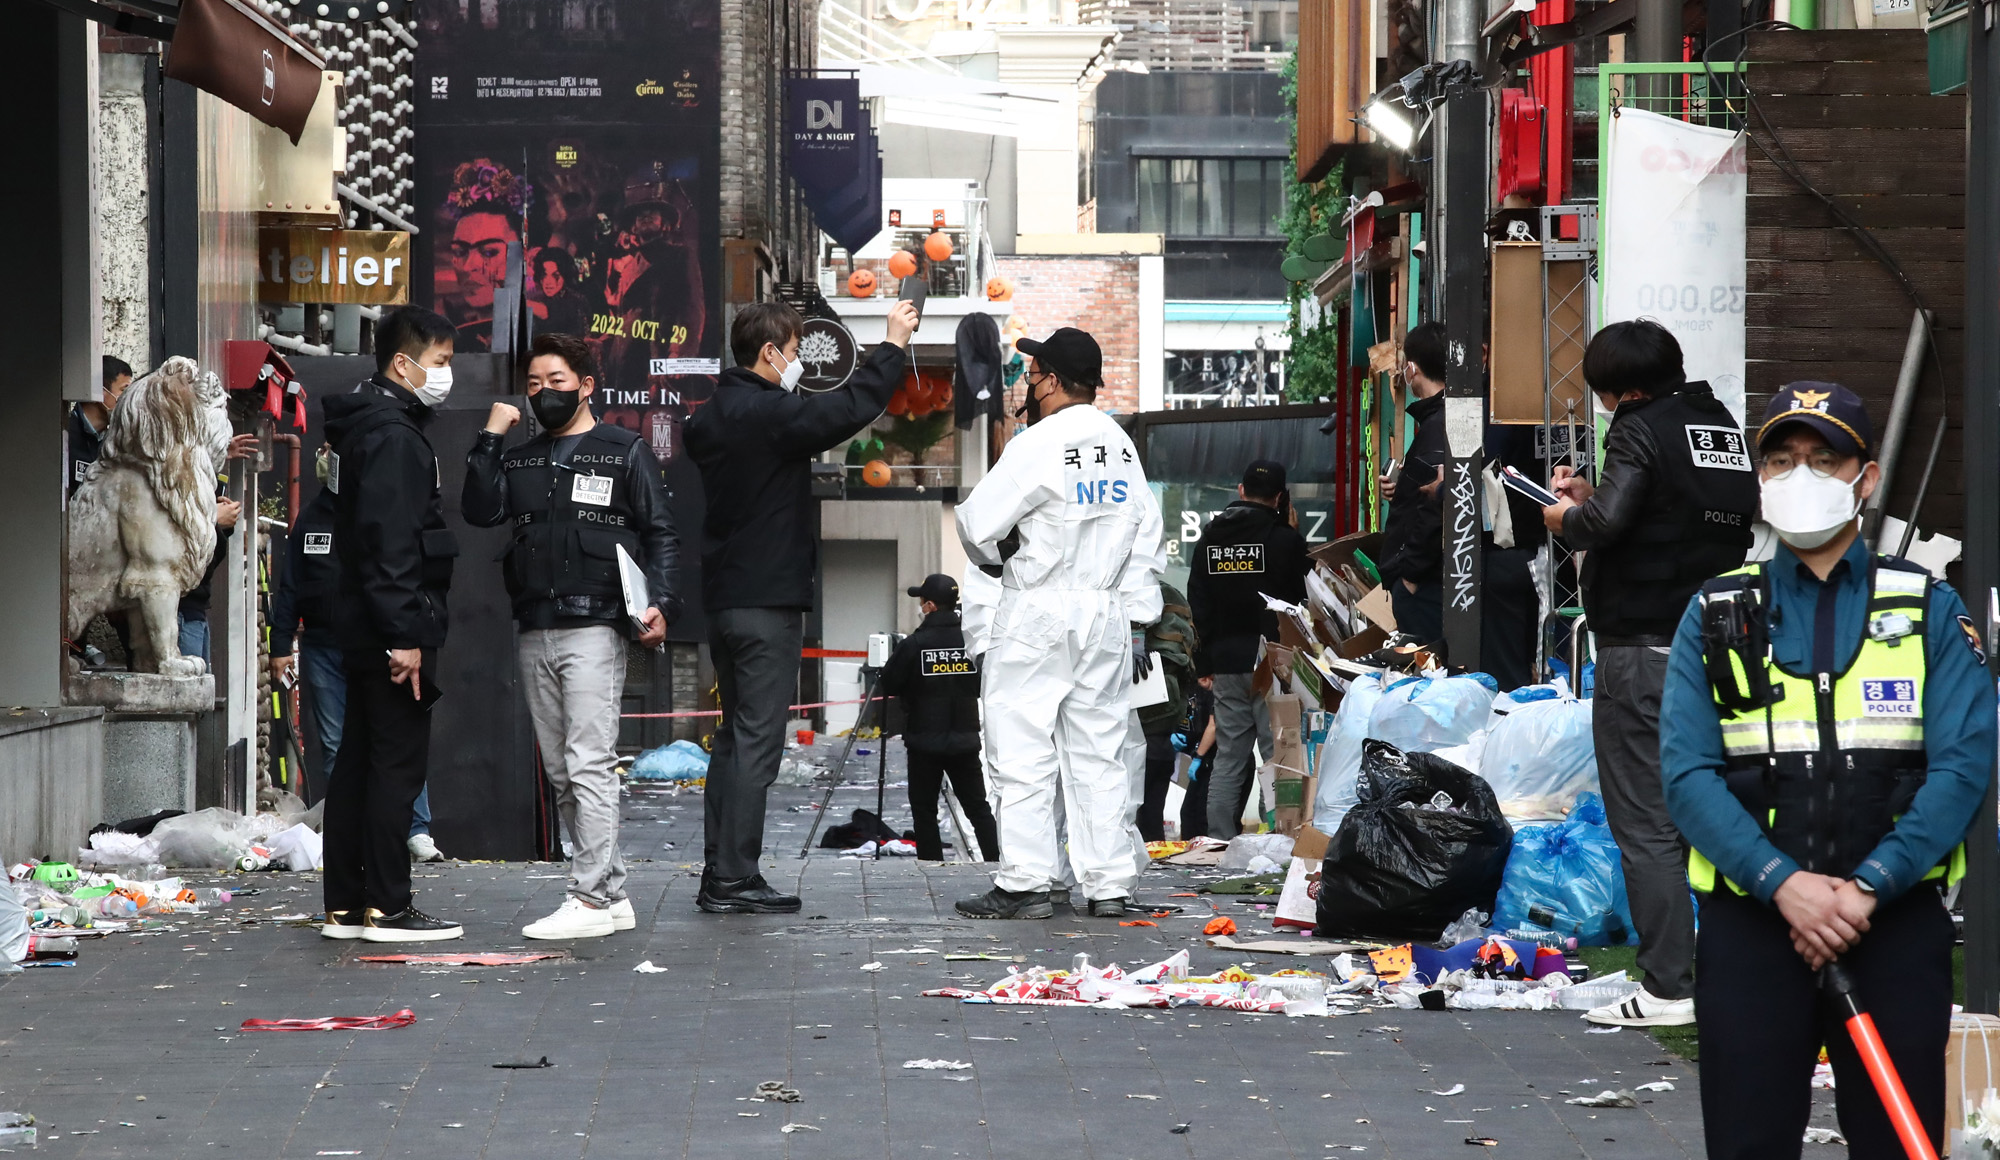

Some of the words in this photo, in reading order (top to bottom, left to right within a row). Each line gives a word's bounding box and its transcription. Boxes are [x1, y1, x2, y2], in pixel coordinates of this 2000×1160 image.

[477, 77, 497, 87] TICKET
[560, 76, 576, 87] OPEN
[636, 83, 664, 96] Cuervo
[556, 151, 577, 160] MEXI
[259, 247, 401, 286] telier
[591, 313, 627, 338] 2022.
[632, 319, 659, 341] OCT
[670, 325, 687, 345] 29
[653, 361, 664, 373] R
[1695, 431, 1741, 452] 경찰
[503, 457, 546, 471] POLICE
[573, 454, 624, 465] POLICE
[1700, 453, 1744, 466] POLICE
[575, 491, 607, 503] DETECTIVE
[1076, 479, 1128, 505] NFS
[577, 509, 625, 526] POLICE
[1705, 510, 1741, 526] POLICE
[1211, 546, 1260, 560] 과학수사
[1217, 560, 1254, 572] POLICE
[932, 662, 968, 673] POLICE
[1865, 681, 1912, 700] 경찰
[1868, 704, 1912, 712] POLICE
